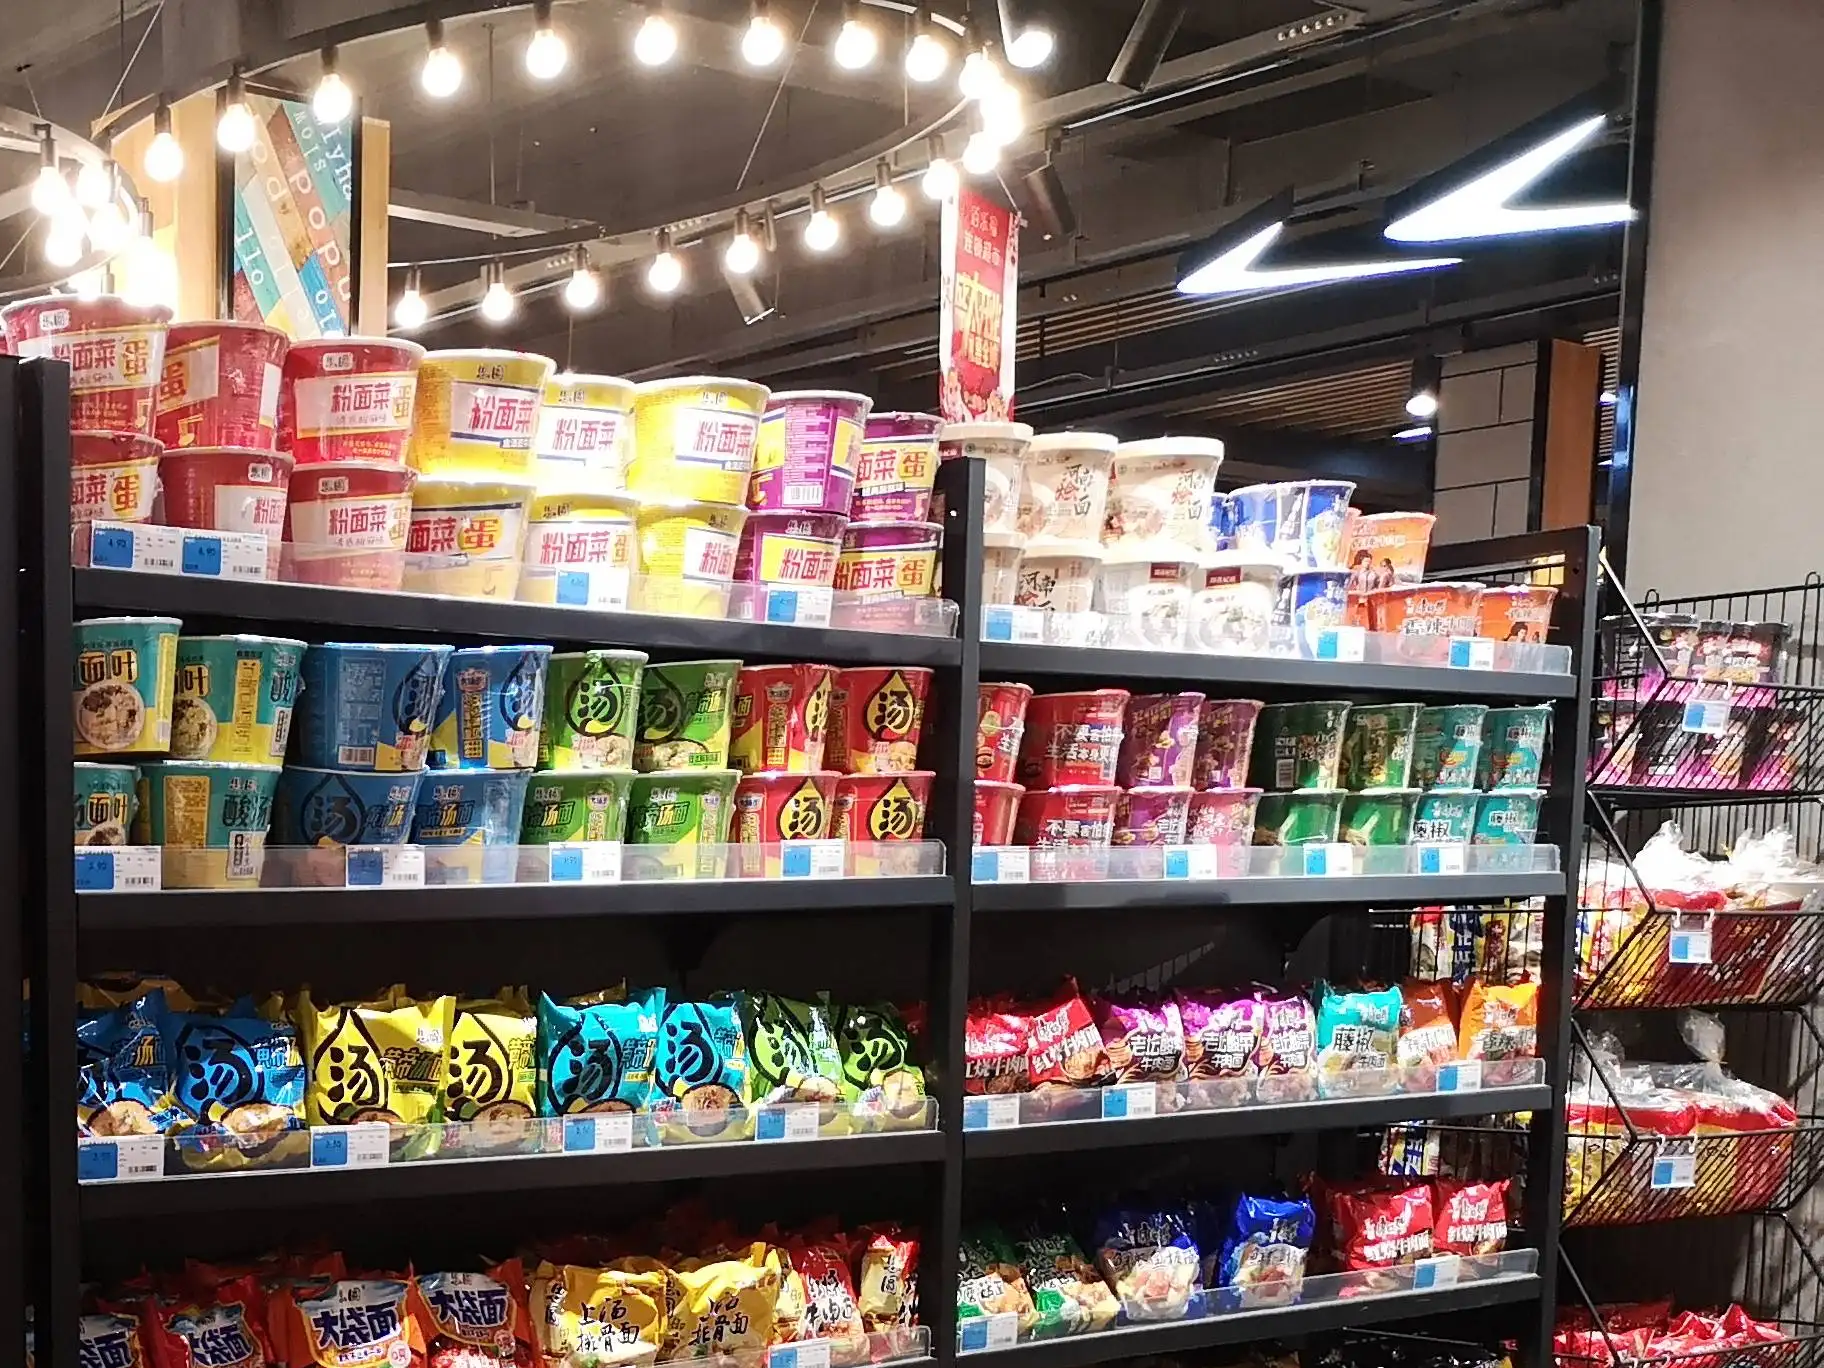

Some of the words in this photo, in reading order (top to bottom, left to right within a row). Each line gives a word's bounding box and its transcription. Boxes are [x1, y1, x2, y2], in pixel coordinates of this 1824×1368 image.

[577, 679, 616, 720] 汤
[875, 690, 912, 731] 汤
[788, 796, 823, 836] 汤
[878, 796, 914, 835] 汤
[184, 1038, 254, 1102] 汤
[446, 1039, 503, 1104] 汤
[562, 1038, 613, 1100] 汤
[665, 1020, 715, 1083] 汤
[328, 1044, 380, 1106] 汤
[312, 1300, 399, 1348] 大袋面
[429, 1289, 508, 1325] 大袋面
[576, 1322, 640, 1353] 排骨面
